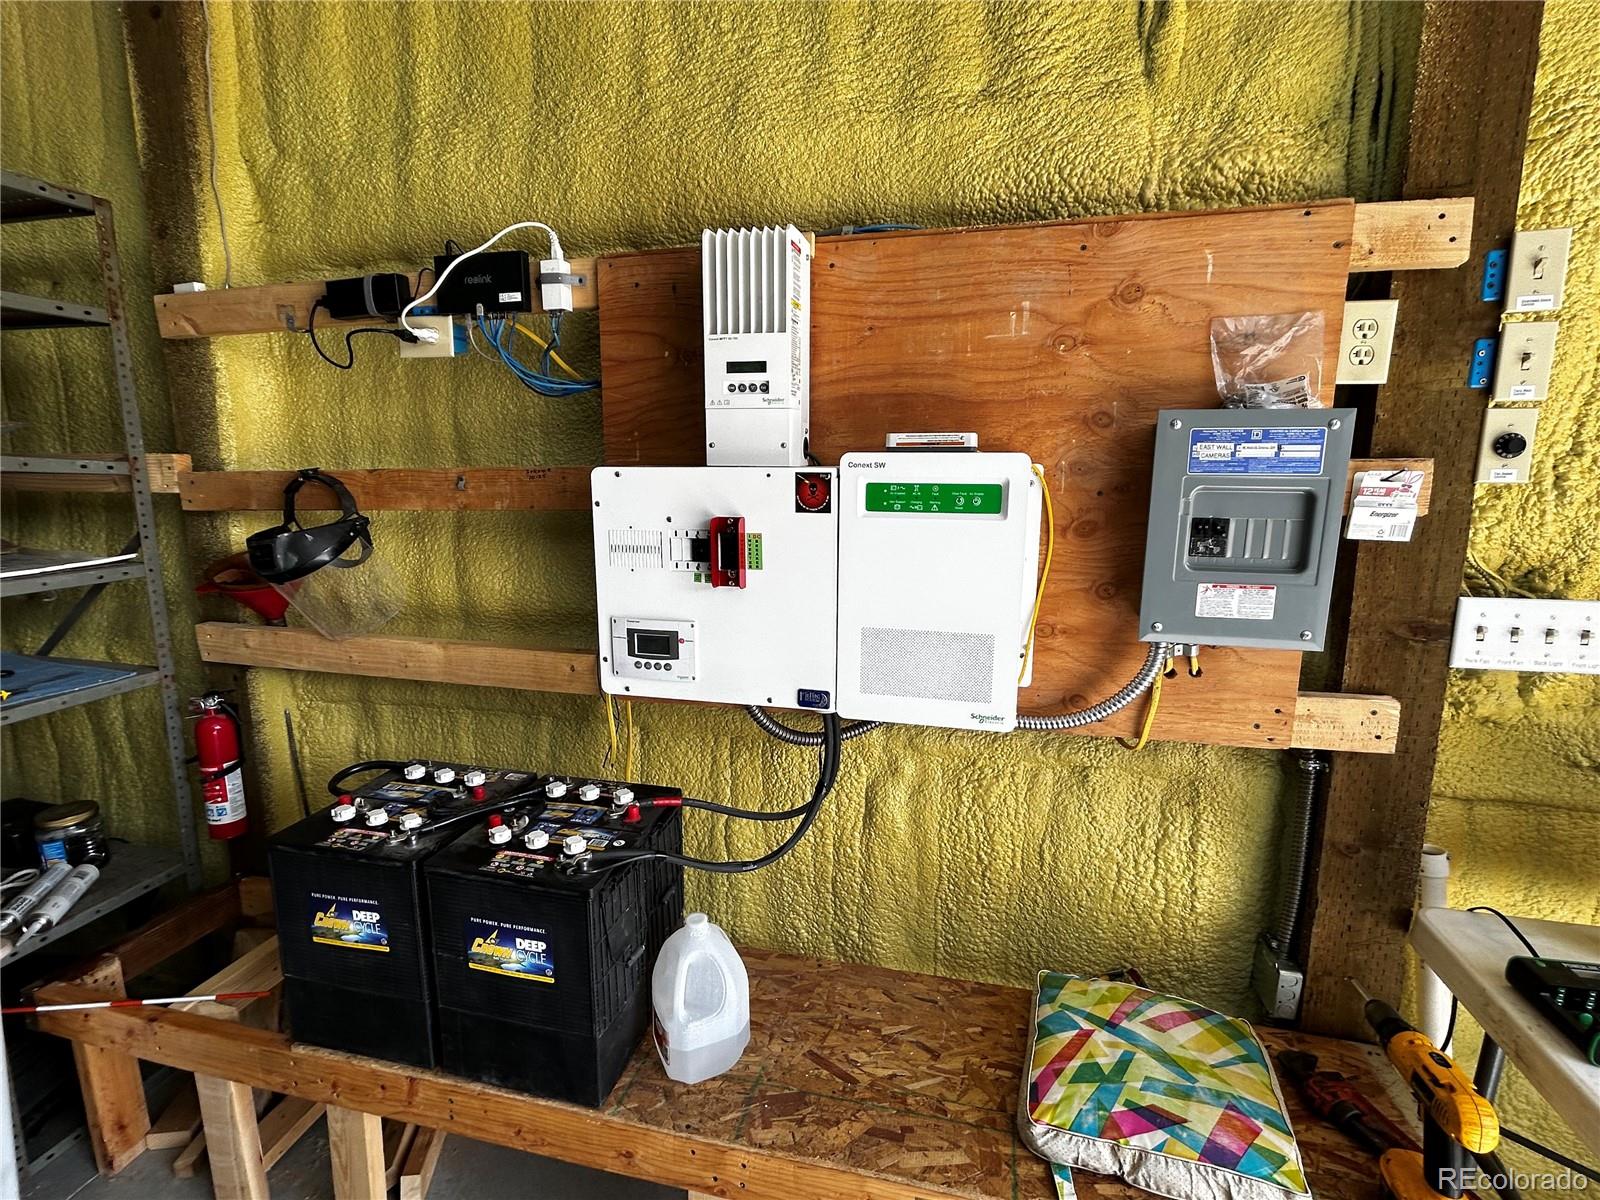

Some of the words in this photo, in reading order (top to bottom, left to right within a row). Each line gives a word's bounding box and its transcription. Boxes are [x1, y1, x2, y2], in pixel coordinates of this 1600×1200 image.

[970, 713, 1005, 721] Schneider
[352, 910, 380, 923] DEEP
[353, 921, 381, 934] CYCLE
[470, 916, 482, 924] PURE
[482, 918, 500, 927] POWER.
[512, 924, 547, 934] PERFORMANCE.
[515, 937, 547, 953] DEEP
[516, 949, 547, 964] CYCLE
